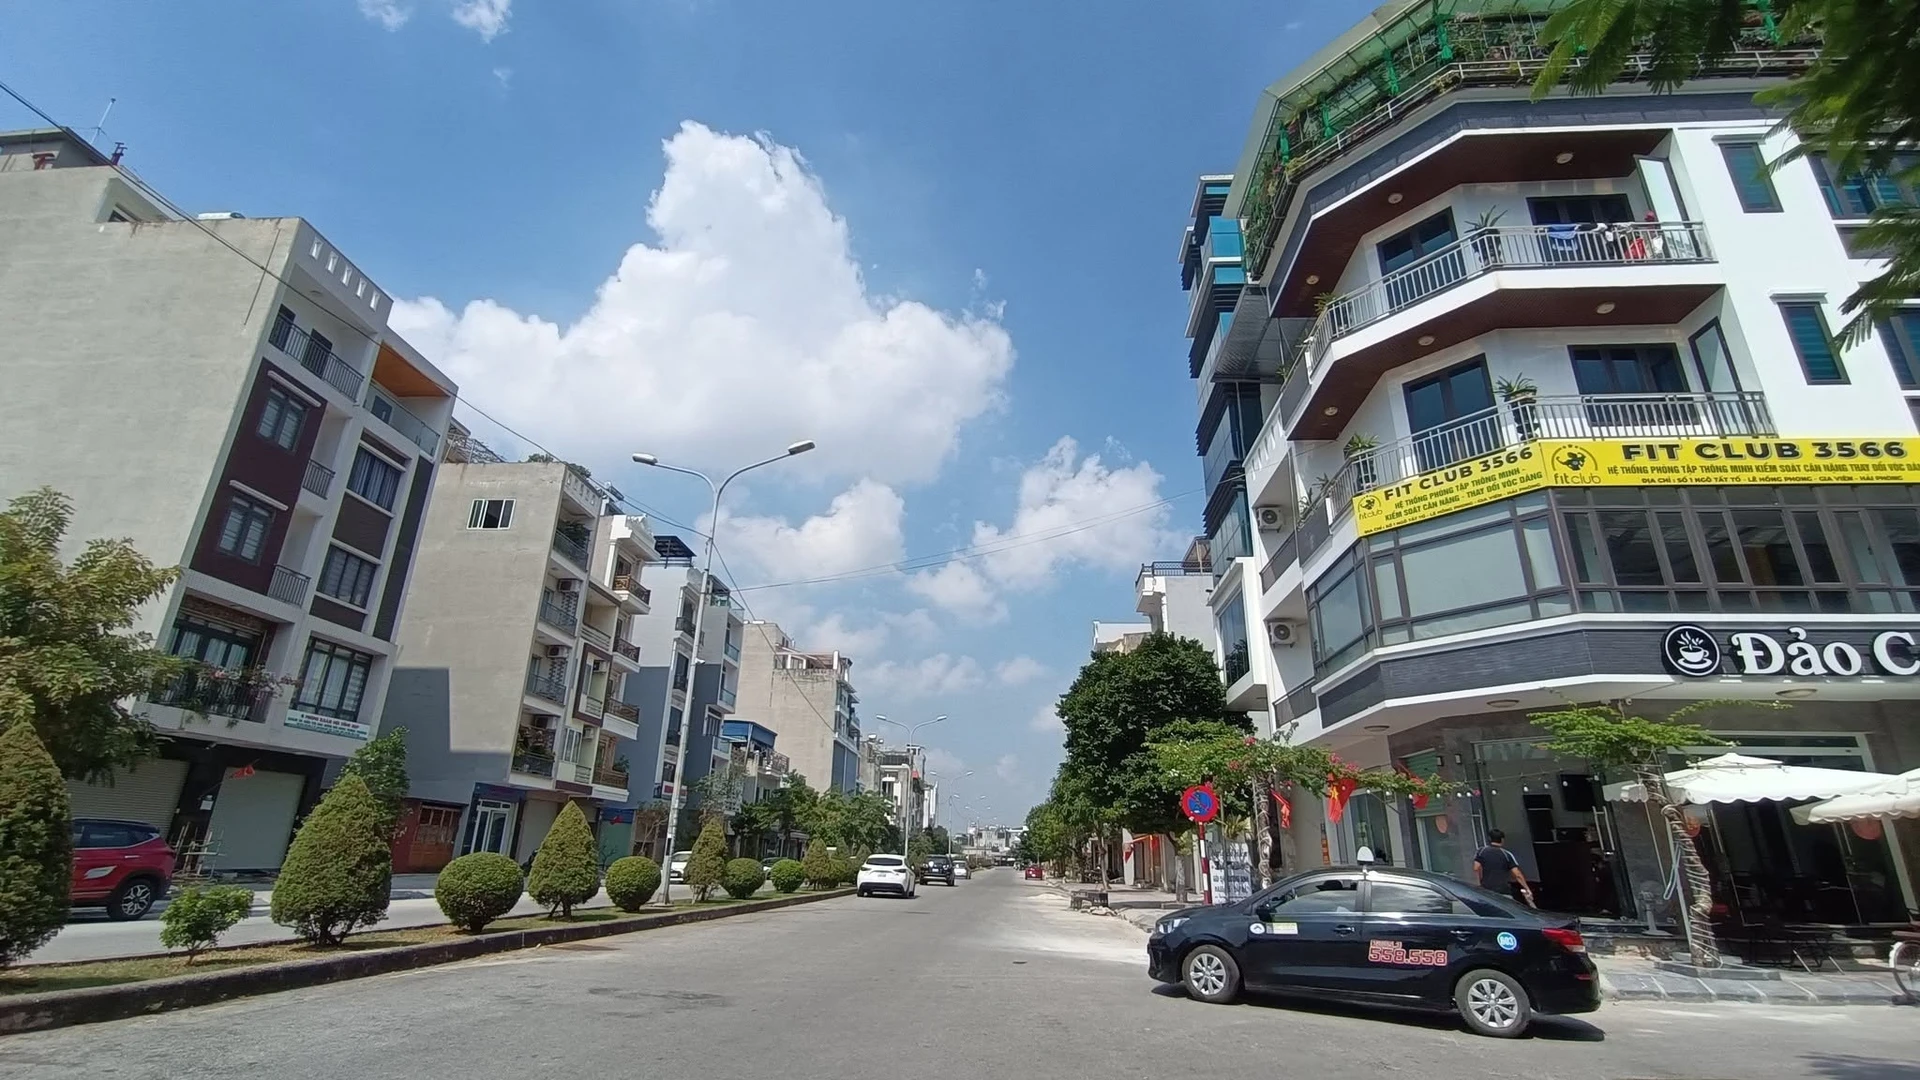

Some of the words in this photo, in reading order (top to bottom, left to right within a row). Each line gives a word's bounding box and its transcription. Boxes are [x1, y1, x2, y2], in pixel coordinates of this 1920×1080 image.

[1622, 444, 1680, 460] FIT
[1695, 443, 1800, 459] CLUB
[1812, 441, 1906, 458] 3566
[1384, 482, 1413, 501] FIT
[1418, 466, 1473, 490] CLUB
[1480, 446, 1533, 472] 3566
[1498, 467, 1520, 480] MINH
[1607, 465, 1619, 476] HỆ
[1620, 464, 1648, 475] THỐNG
[1650, 464, 1679, 474] PHÒNG
[1680, 464, 1697, 475] TẬP
[1699, 463, 1728, 474] THÔNG
[1730, 464, 1753, 473] MINH
[1779, 463, 1801, 473] SOÁT
[1849, 463, 1870, 472] THAY
[1554, 473, 1601, 484] fitclub
[1466, 487, 1485, 498] THAY
[1731, 627, 1863, 676] Đảo
[1368, 947, 1447, 966] 558.558
